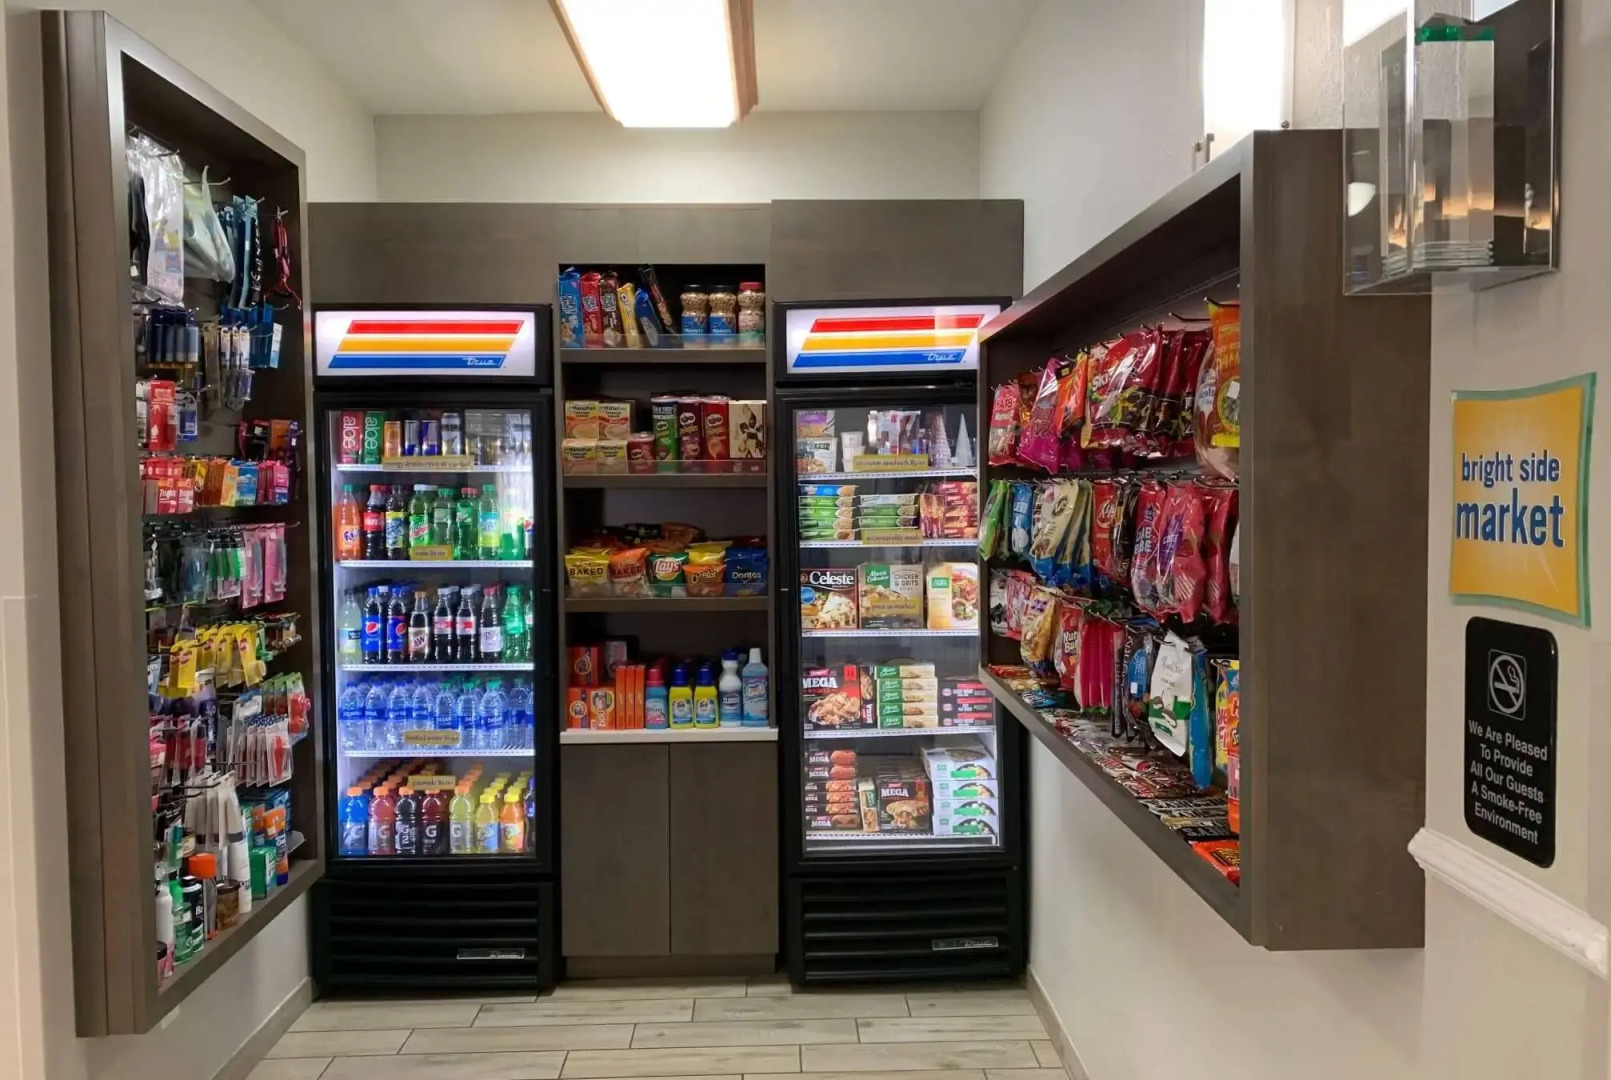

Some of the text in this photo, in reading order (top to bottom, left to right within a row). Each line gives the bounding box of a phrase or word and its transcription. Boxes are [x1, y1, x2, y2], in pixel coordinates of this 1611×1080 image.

[1461, 449, 1560, 488] bright side
[1456, 487, 1564, 548] market
[569, 567, 604, 576] BAKED
[731, 571, 762, 580] Doritos
[809, 571, 854, 586] Celeste
[803, 677, 838, 688] MEGA
[1468, 718, 1548, 761] We Are Pleased
[1480, 743, 1533, 777] To Provide
[1470, 760, 1544, 804] All Our Guests
[881, 788, 909, 798] MEGA
[1471, 780, 1542, 825] A Smoke-Free
[426, 824, 437, 838] G
[451, 824, 462, 838] G
[1474, 802, 1539, 845] Environment
[402, 835, 410, 844] 2
